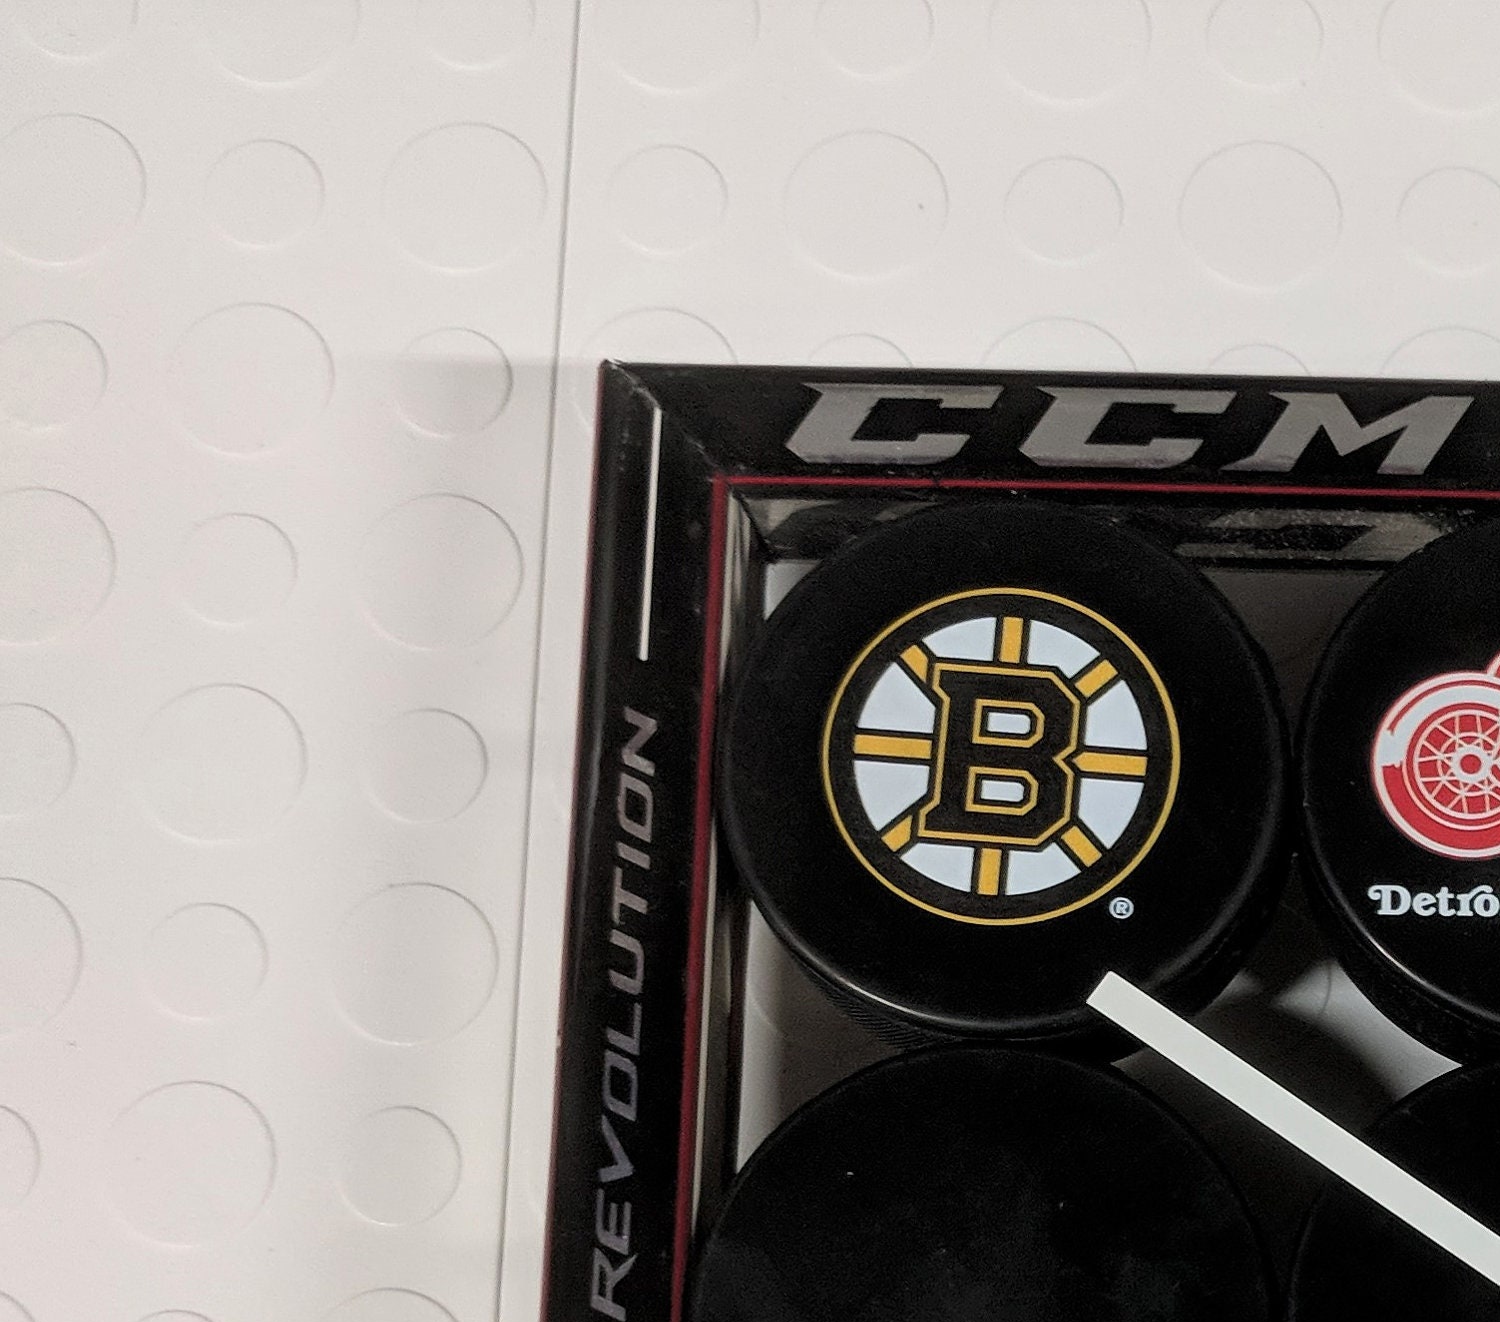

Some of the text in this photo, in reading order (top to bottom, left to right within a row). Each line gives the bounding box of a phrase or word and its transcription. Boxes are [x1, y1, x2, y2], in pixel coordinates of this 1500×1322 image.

[785, 383, 1475, 476] CCM
[917, 660, 1082, 848] B
[590, 706, 659, 1322] REVOLUTION
